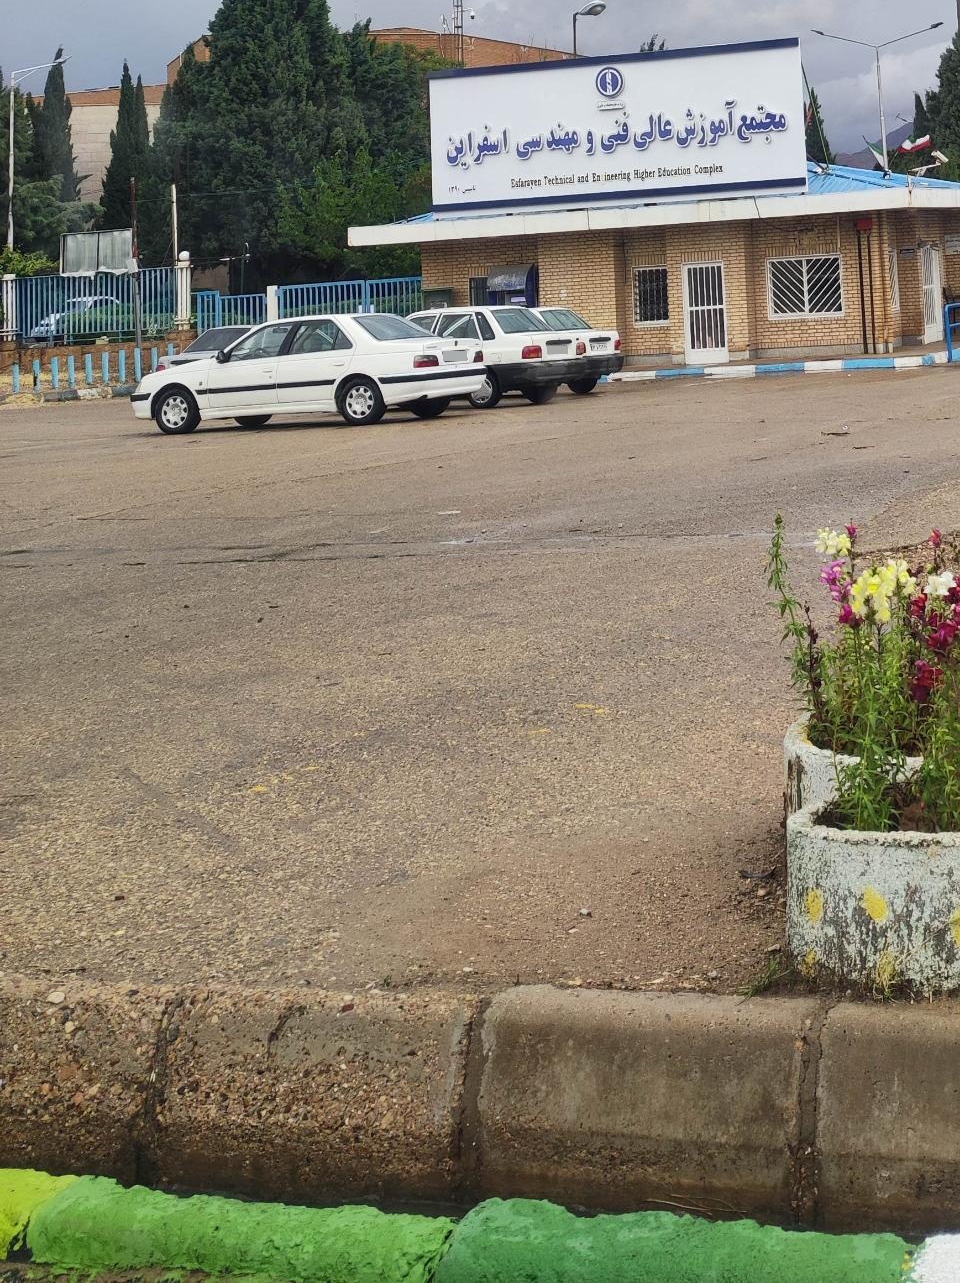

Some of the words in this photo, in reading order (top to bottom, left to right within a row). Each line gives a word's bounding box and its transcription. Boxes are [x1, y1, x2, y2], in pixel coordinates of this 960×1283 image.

[516, 124, 580, 160] مهندسی
[585, 129, 595, 155] و
[600, 111, 631, 152] فنی
[633, 113, 674, 150] عالی
[676, 100, 736, 147] آموزش
[737, 105, 787, 143] مجتمع
[446, 125, 509, 169] اسفراین
[511, 178, 542, 190] Esfarayen
[544, 173, 575, 186] Technical
[577, 172, 589, 184] and
[592, 170, 631, 183] Enineering
[633, 168, 656, 182] Higher
[657, 164, 691, 178] Education
[694, 162, 723, 178] Complex
